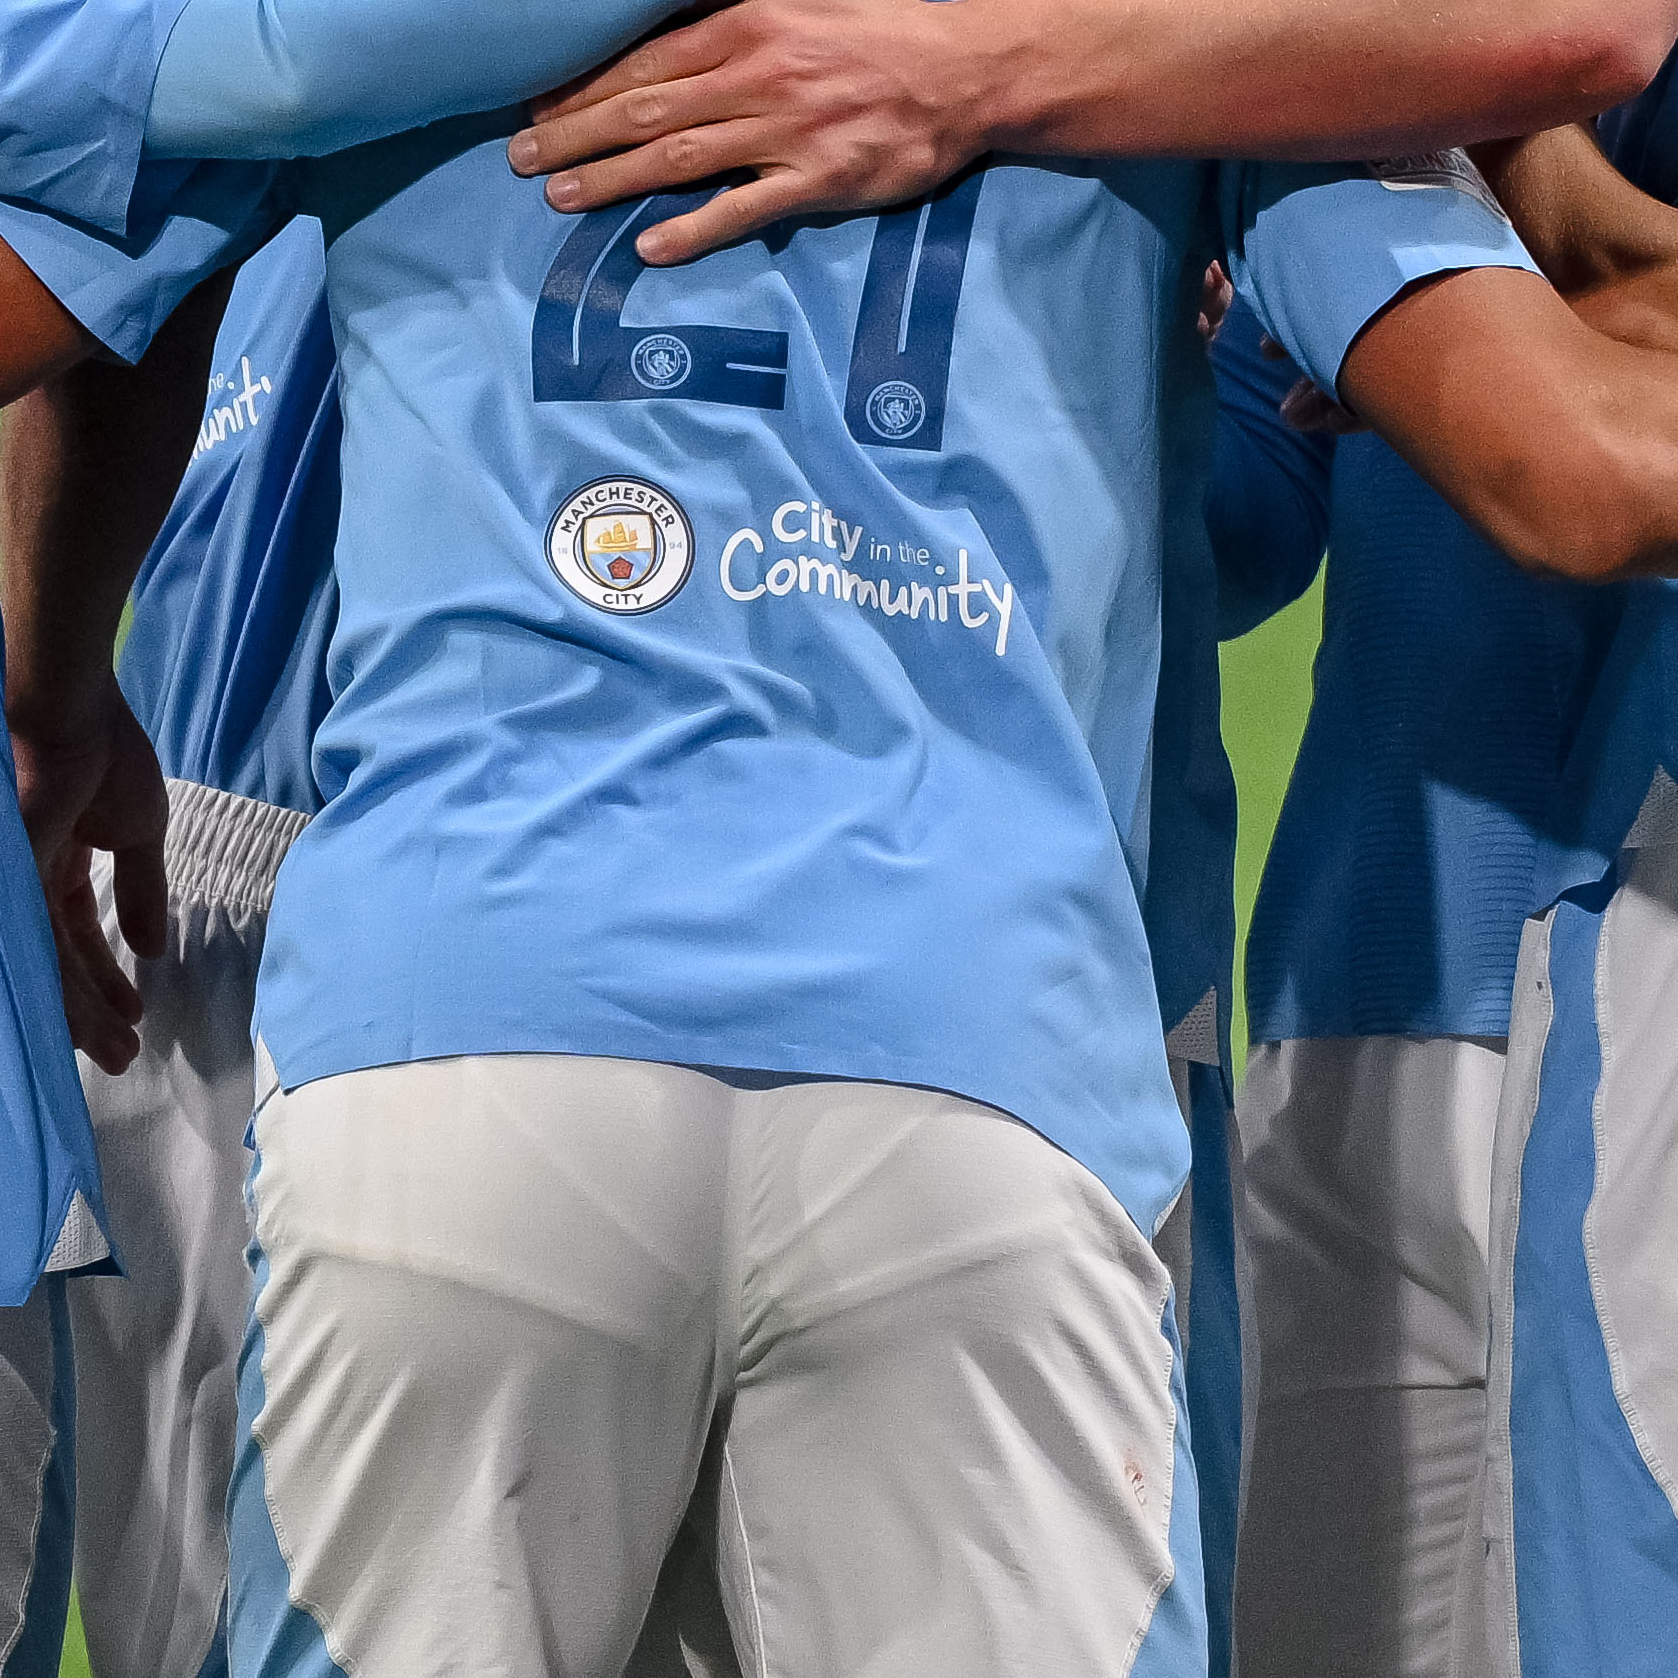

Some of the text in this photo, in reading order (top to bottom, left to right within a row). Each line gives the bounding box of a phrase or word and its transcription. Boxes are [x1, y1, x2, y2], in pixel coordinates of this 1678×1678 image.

[560, 486, 676, 534] MANCHESTER
[771, 499, 930, 566] City in the
[602, 593, 644, 605] CITY
[719, 527, 1013, 657] Community
